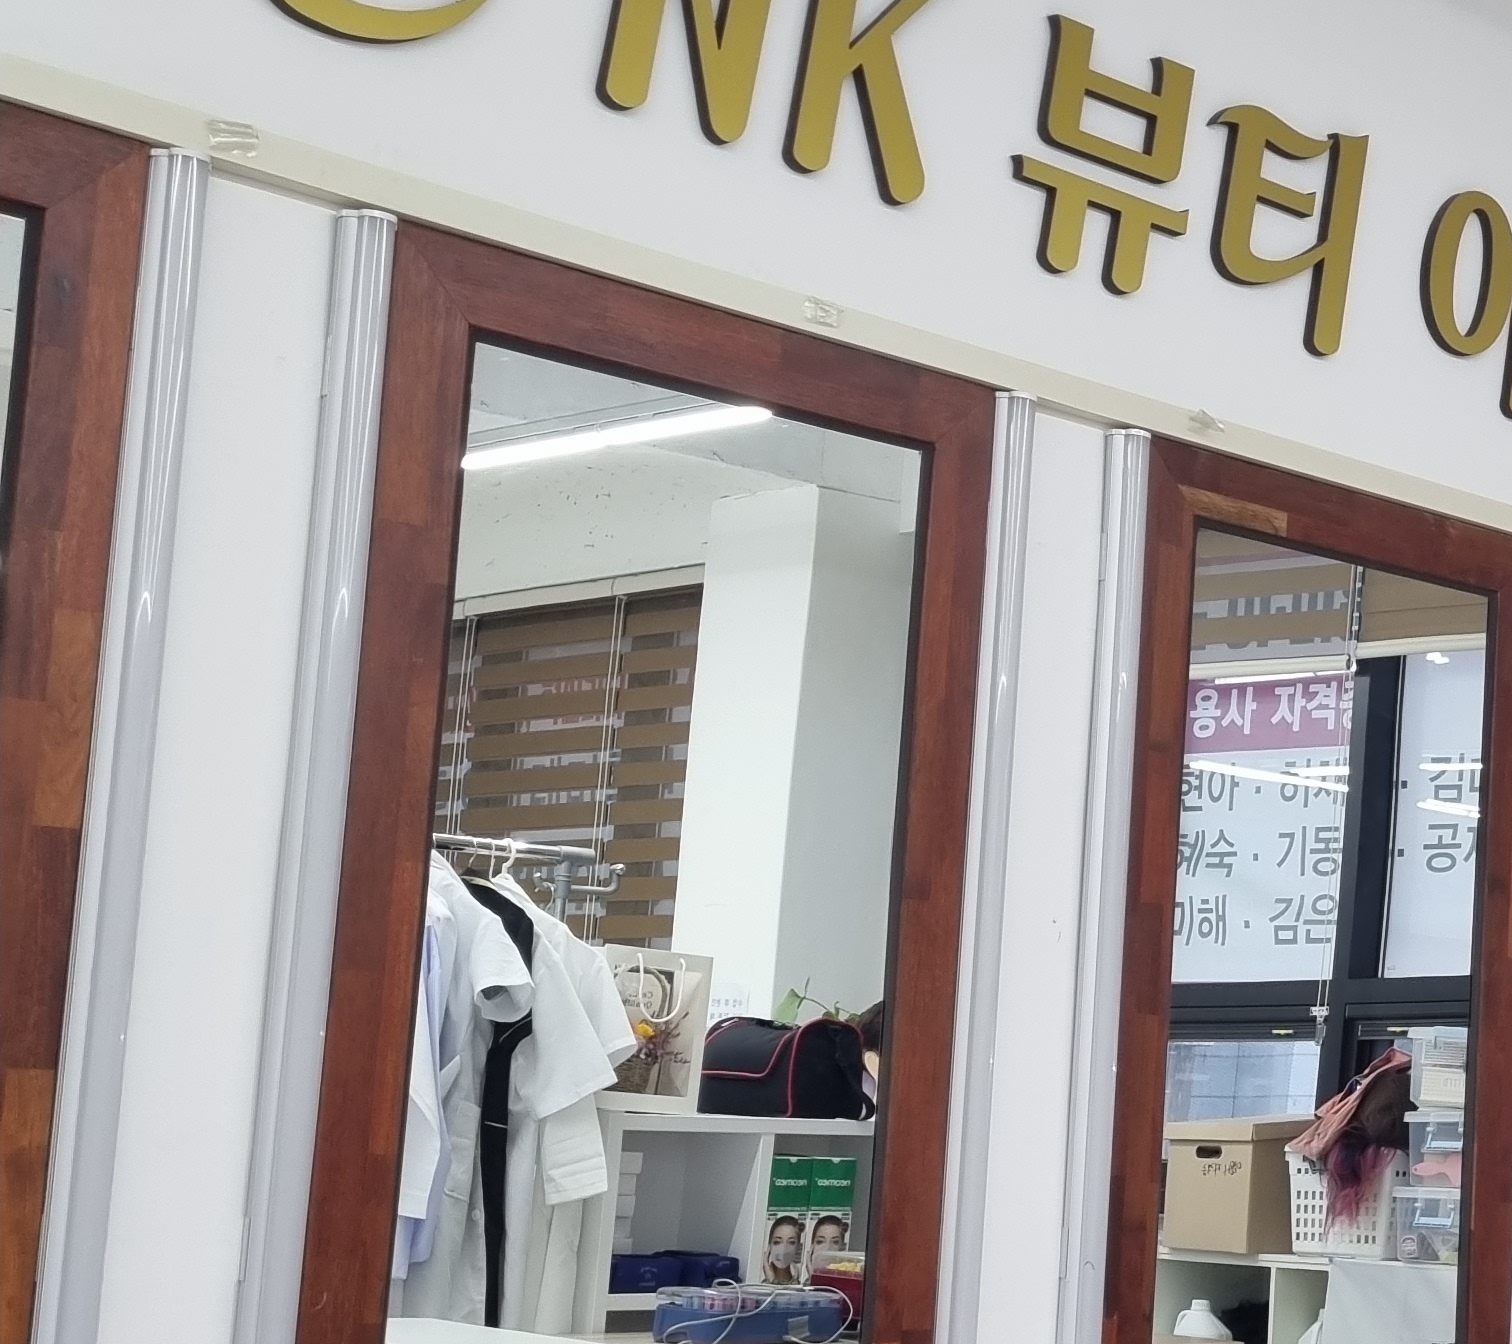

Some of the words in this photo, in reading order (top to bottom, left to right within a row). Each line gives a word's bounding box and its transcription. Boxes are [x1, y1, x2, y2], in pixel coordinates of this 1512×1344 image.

[1011, 13, 1369, 357] 뷰티
[1190, 689, 1257, 738] 용사
[1276, 826, 1343, 877] 기동
[1268, 893, 1337, 945] 김은
